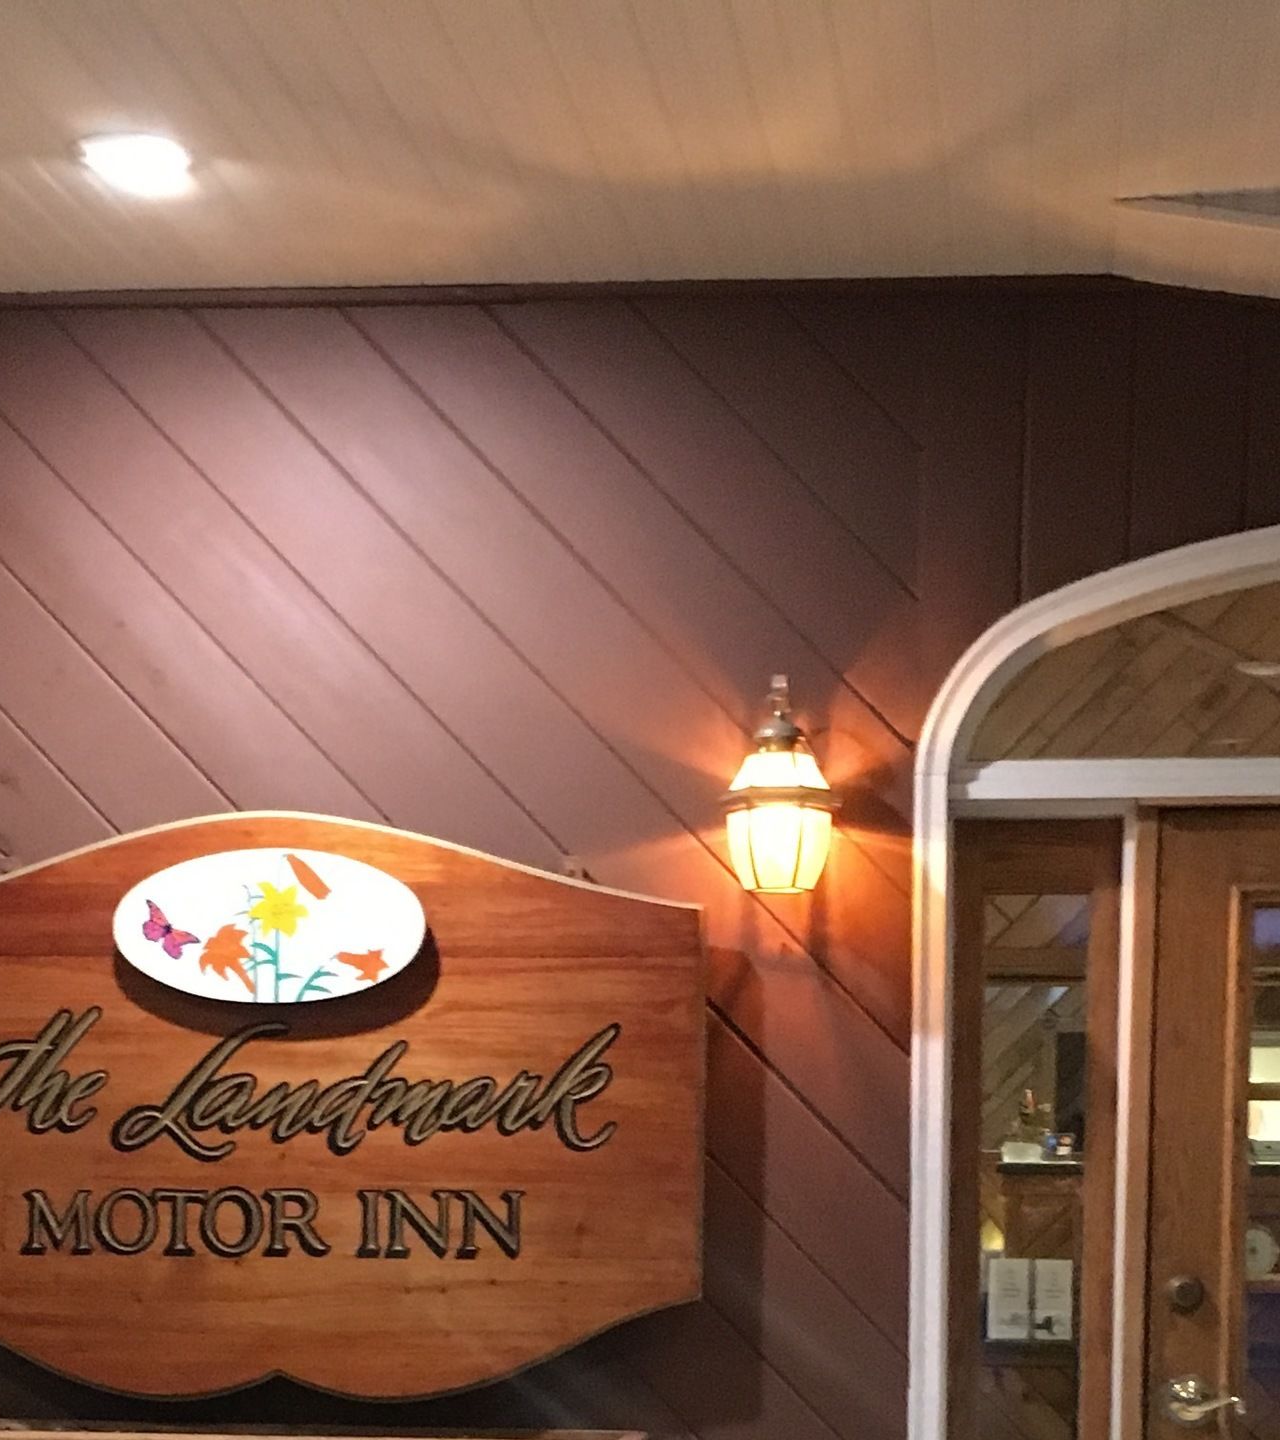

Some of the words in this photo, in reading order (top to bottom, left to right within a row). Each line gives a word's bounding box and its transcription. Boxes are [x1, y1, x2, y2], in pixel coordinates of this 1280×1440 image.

[111, 1020, 622, 1162] Landmark
[20, 1186, 331, 1258] MOTOR
[355, 1189, 527, 1262] INN
